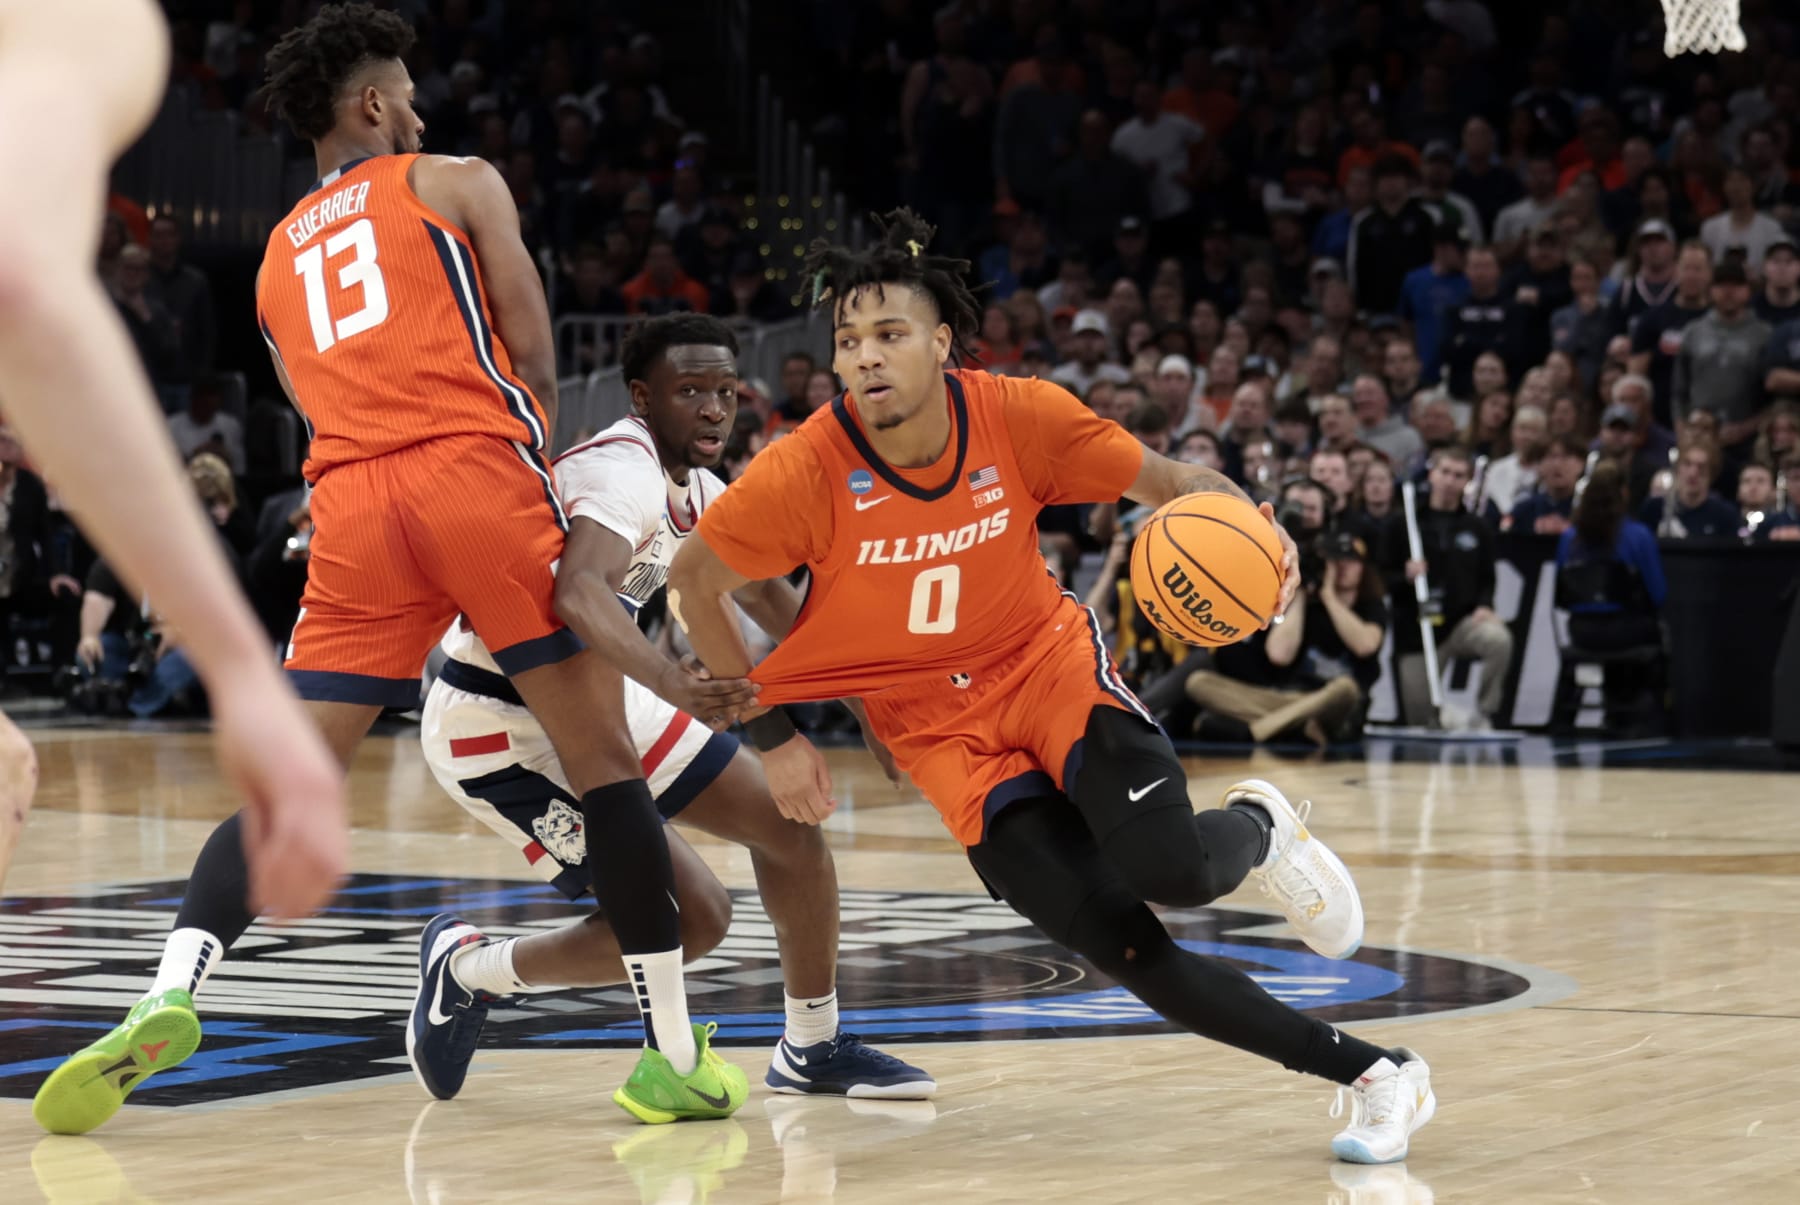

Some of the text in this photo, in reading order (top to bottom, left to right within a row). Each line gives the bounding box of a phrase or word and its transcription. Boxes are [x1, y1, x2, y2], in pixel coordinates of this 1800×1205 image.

[286, 181, 370, 249] GUERRIER
[294, 218, 389, 354] 13
[855, 508, 1010, 566] ILLINOIS
[907, 564, 960, 634] 0
[1162, 561, 1241, 638] Wilson
